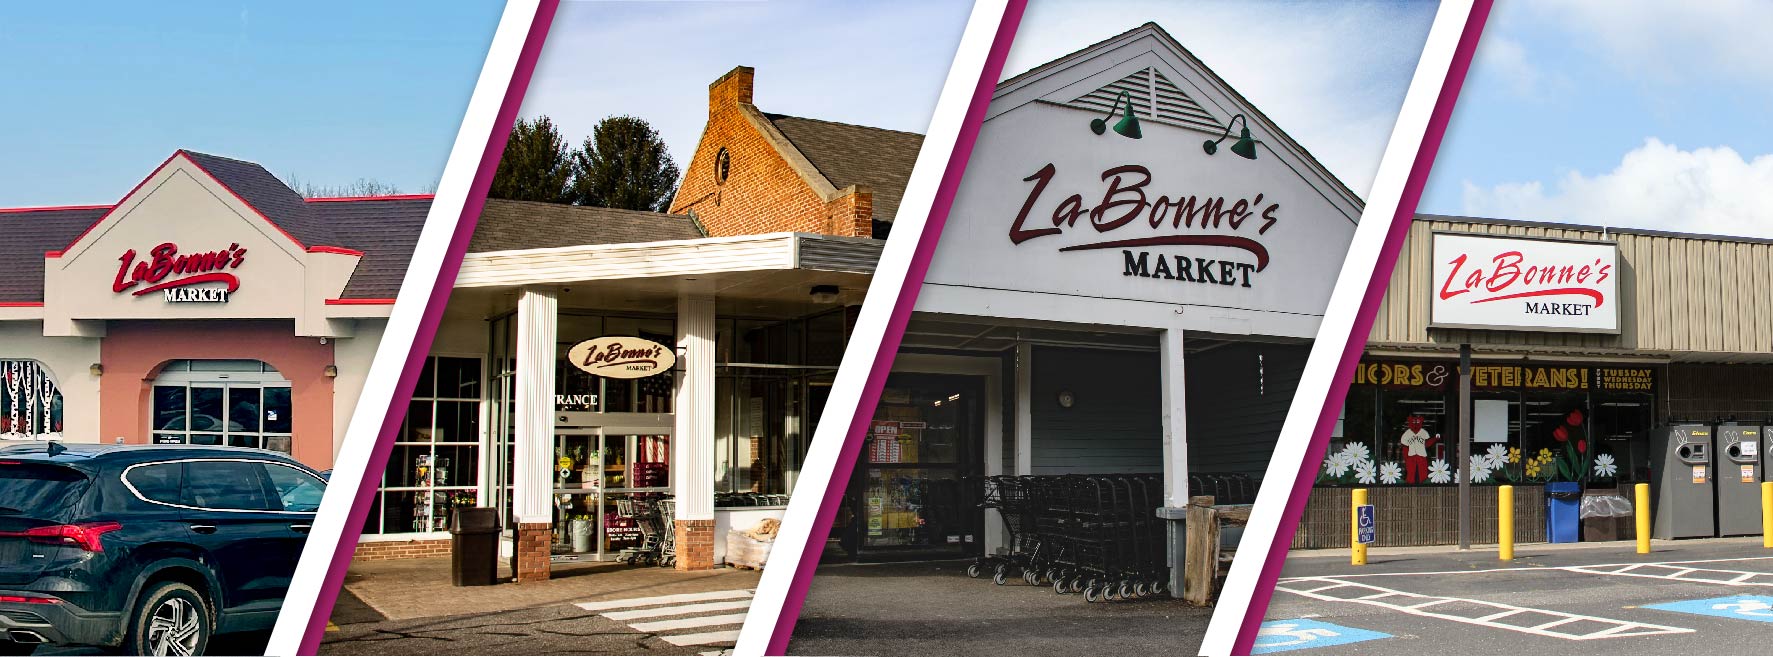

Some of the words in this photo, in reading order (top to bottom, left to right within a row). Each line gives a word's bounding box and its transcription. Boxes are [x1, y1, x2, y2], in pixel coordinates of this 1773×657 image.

[1009, 163, 1279, 245] LaBonne's
[113, 242, 247, 292] LaBonne's
[1123, 250, 1255, 288] MARKET
[1440, 251, 1612, 300] LaBonne's
[163, 288, 228, 302] MARKET
[1525, 302, 1591, 316] MARKET
[583, 342, 662, 366] LaBonne's
[1352, 363, 1424, 386] IORS
[1426, 365, 1449, 386] &
[1603, 369, 1652, 377] TUESDAY
[555, 394, 598, 405] RANCE
